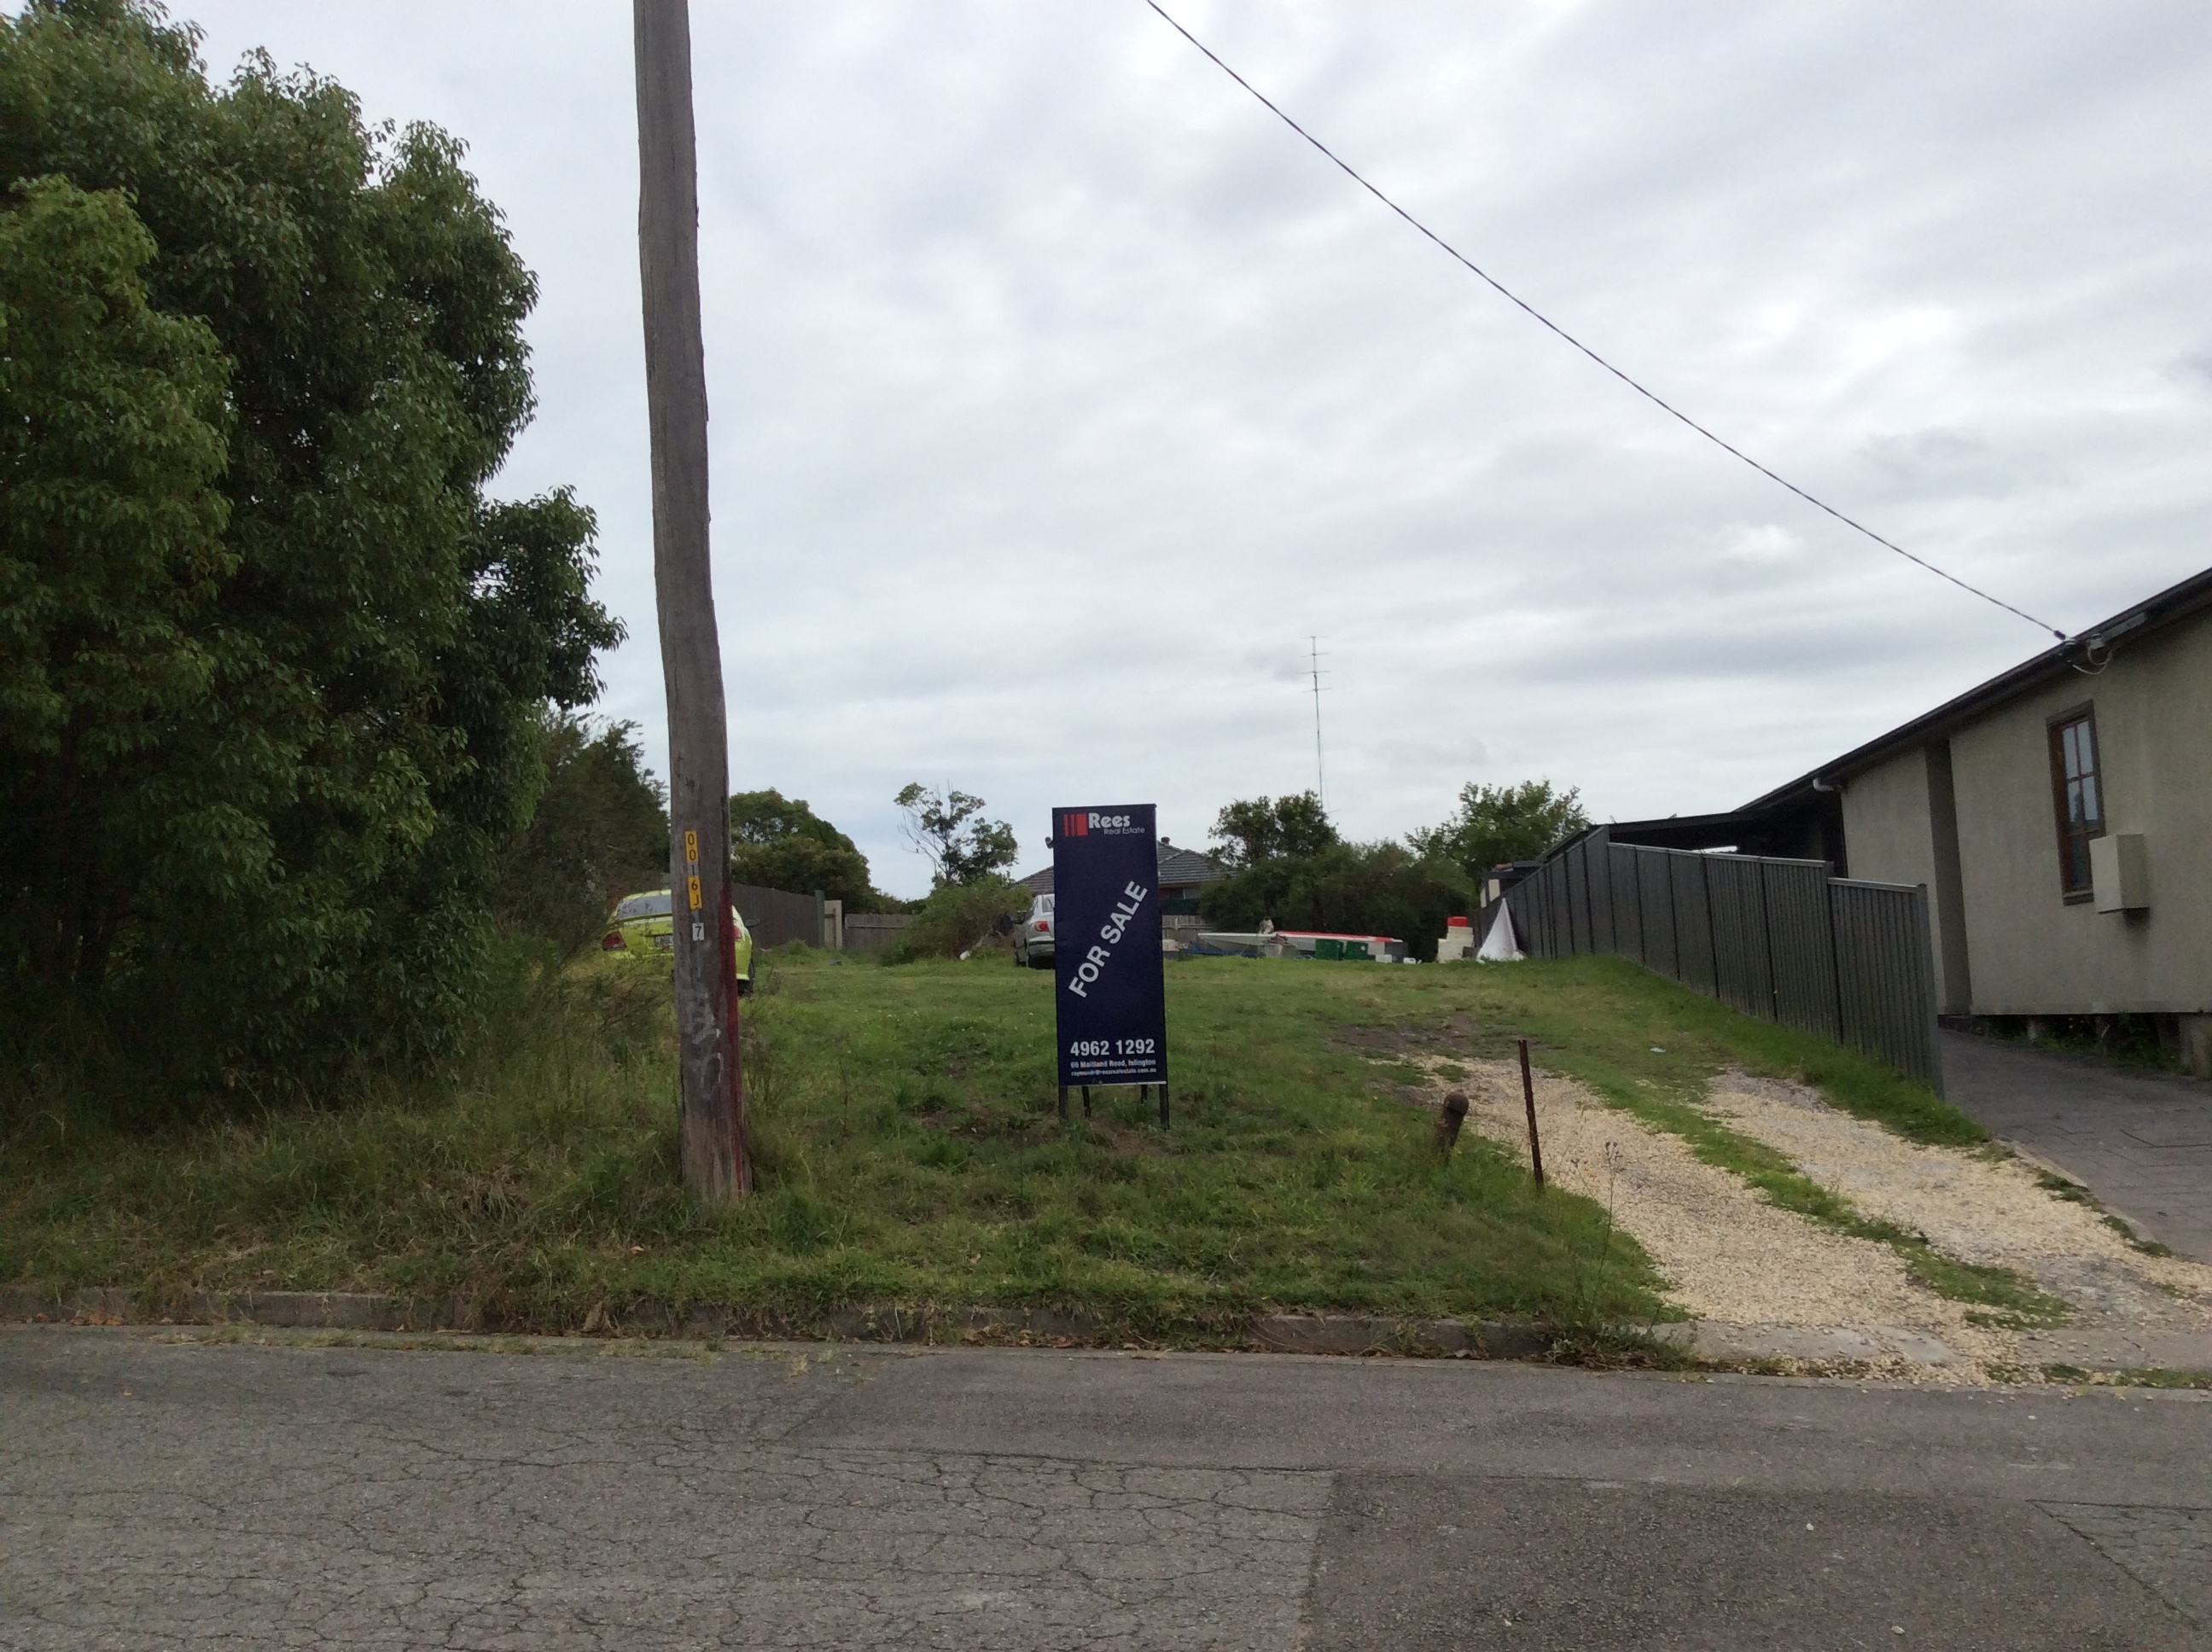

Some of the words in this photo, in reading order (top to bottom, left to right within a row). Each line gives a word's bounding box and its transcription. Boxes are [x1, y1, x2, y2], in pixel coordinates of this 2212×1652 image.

[1088, 812, 1130, 829] Rees
[695, 926, 702, 938] 7
[1068, 945, 1111, 998] FOR
[1100, 880, 1149, 944] SALE
[1070, 1040, 1109, 1056] 4962
[1115, 1038, 1155, 1055] 1292
